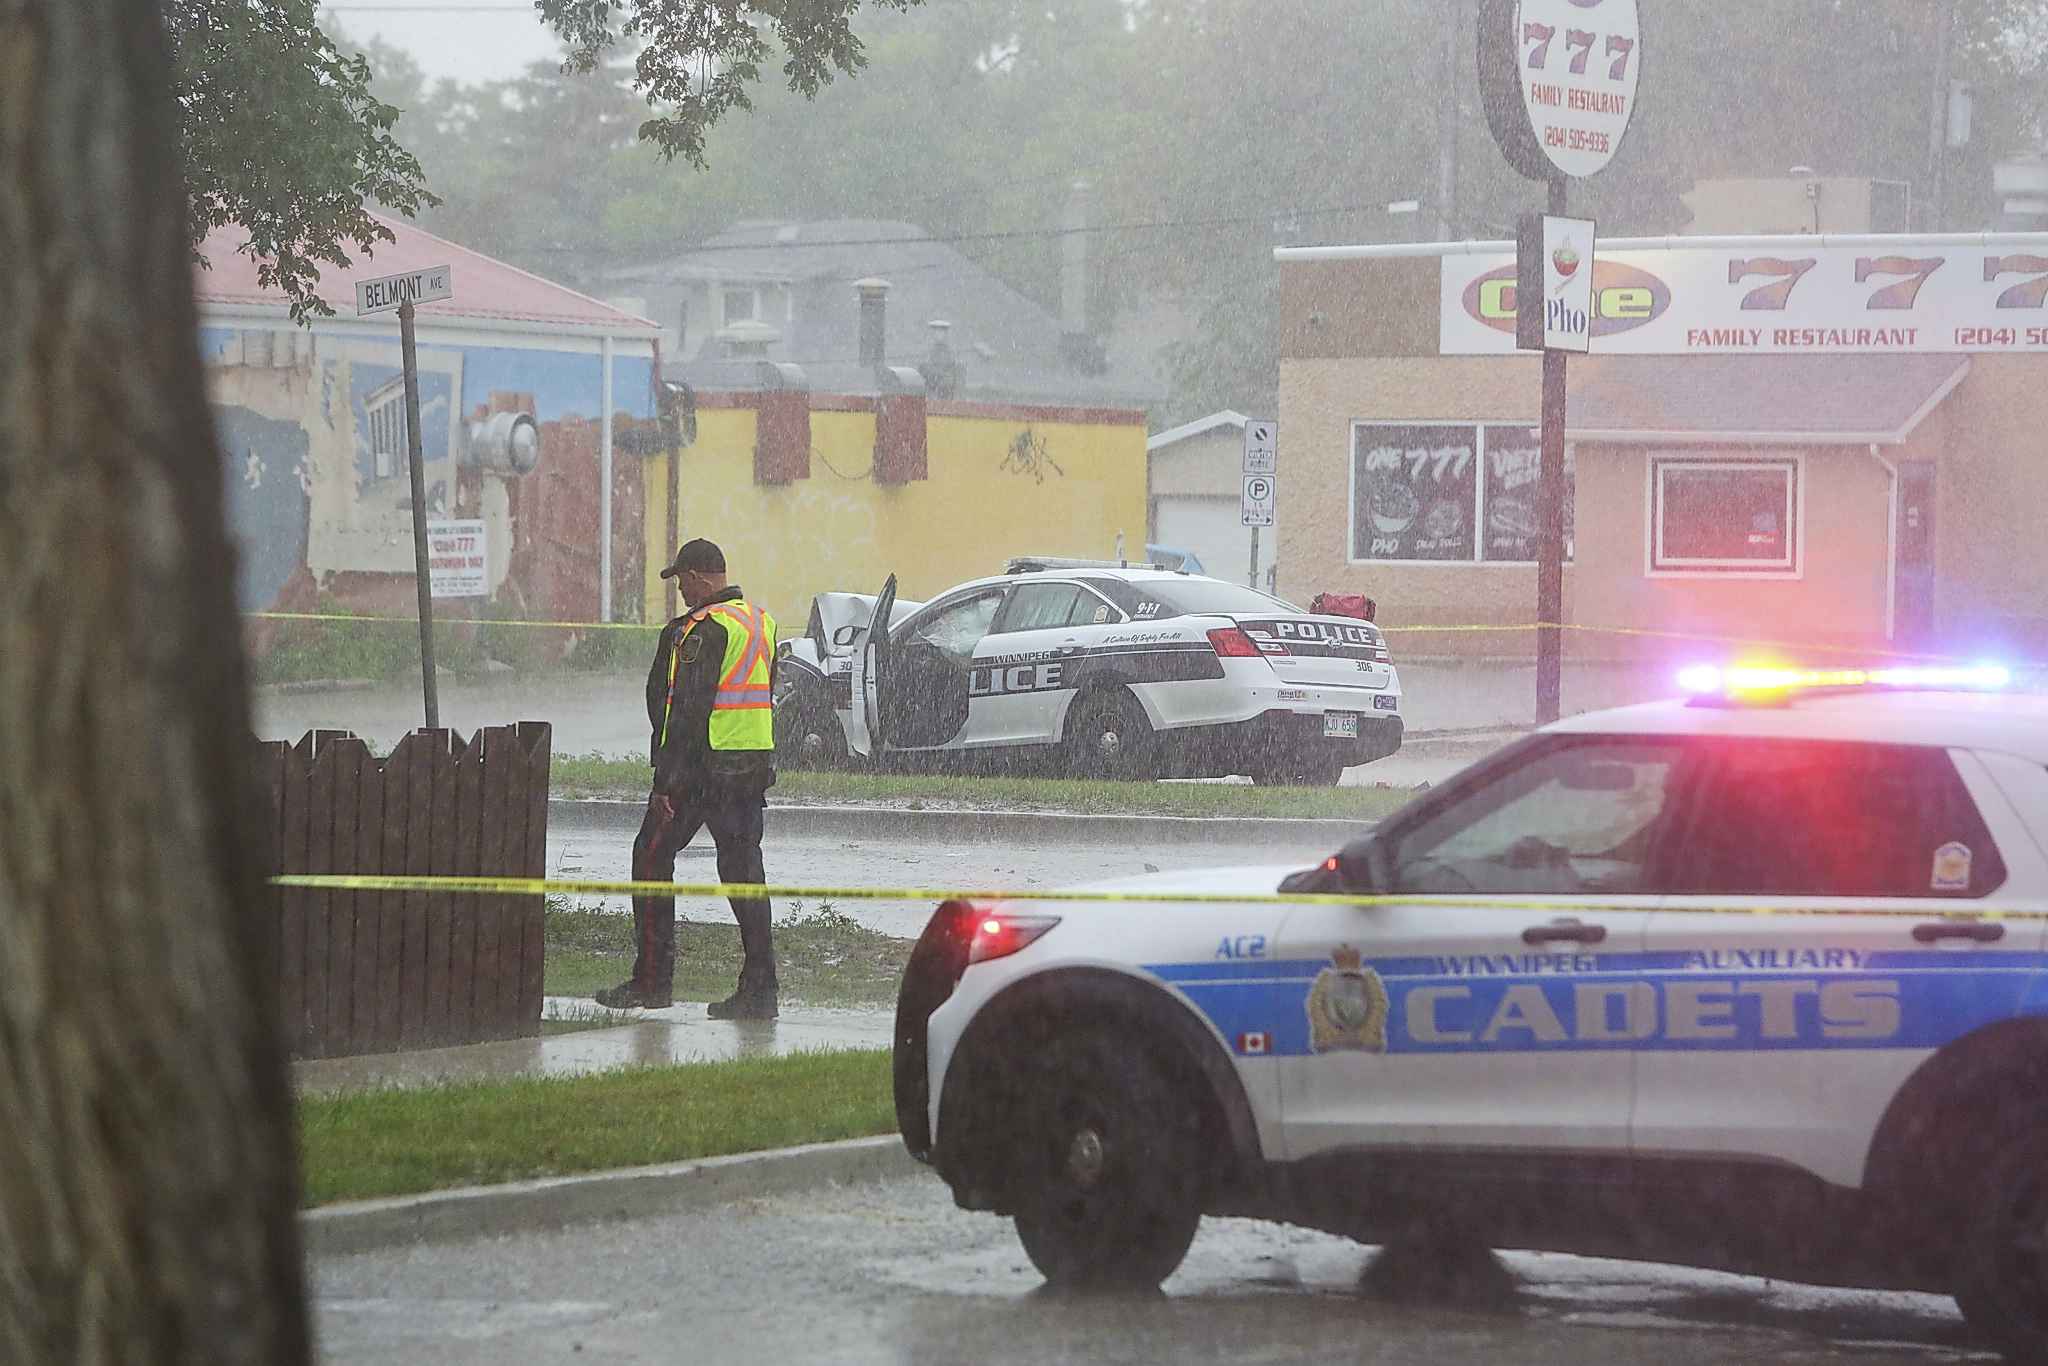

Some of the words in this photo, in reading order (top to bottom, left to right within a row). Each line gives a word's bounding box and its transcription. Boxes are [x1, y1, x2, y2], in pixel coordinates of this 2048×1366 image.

[1531, 82, 1562, 107] FAMILY
[1567, 88, 1626, 115] RESTAURANT
[365, 275, 422, 308] BELMONT
[430, 276, 442, 290] AVE
[1547, 298, 1585, 333] Pho
[1687, 328, 1762, 346] FAMILY
[1773, 327, 1918, 346] RESTAURANT
[1954, 326, 2016, 346] (204)
[1405, 446, 1472, 481] 777
[1275, 623, 1372, 643] POLICE
[992, 650, 1050, 664] WINNIPEG
[1357, 661, 1373, 673] 306
[1216, 936, 1266, 958] AC2
[1436, 953, 1597, 975] WINNIPEG
[1687, 948, 1866, 968] AUXILIARY
[1405, 980, 1900, 1042] CADETS
